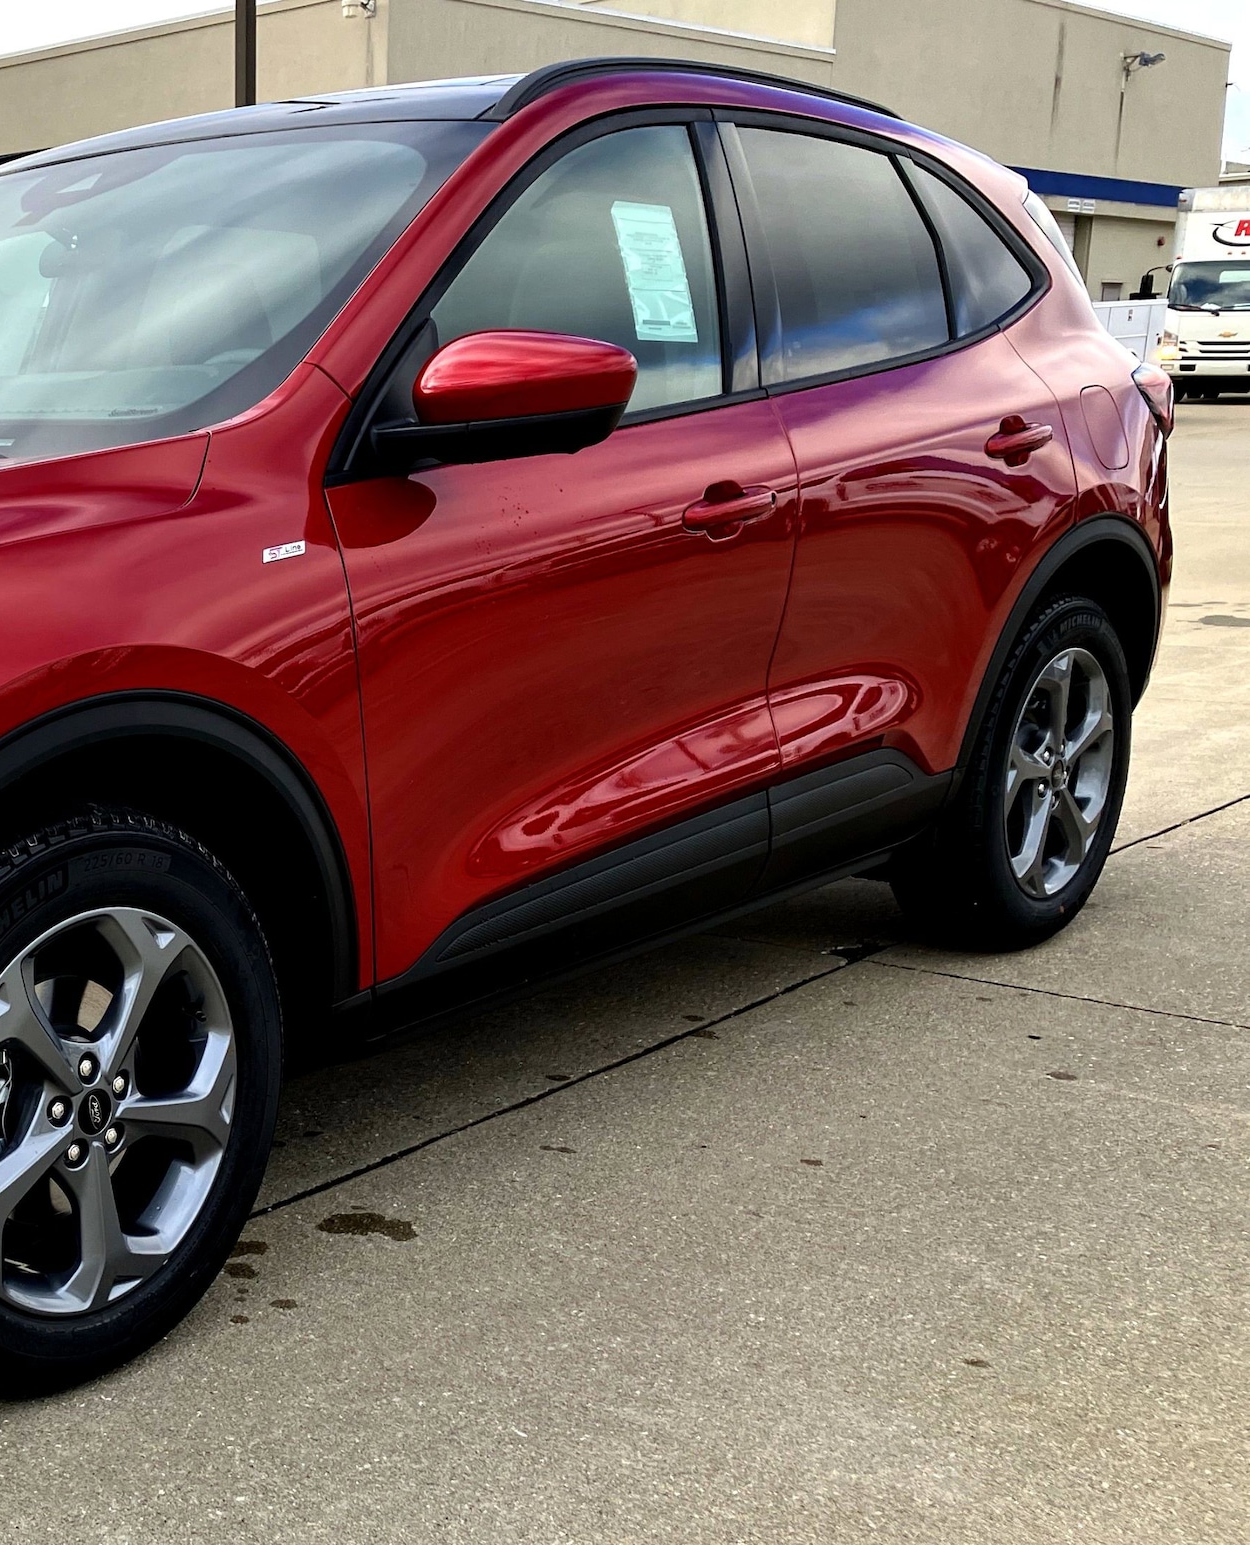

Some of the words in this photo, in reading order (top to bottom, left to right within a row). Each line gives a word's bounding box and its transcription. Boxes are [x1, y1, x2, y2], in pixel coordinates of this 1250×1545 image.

[1060, 613, 1101, 635] MICHELIN
[84, 853, 132, 872] 225/60
[137, 853, 146, 865] R
[151, 856, 164, 868] 18
